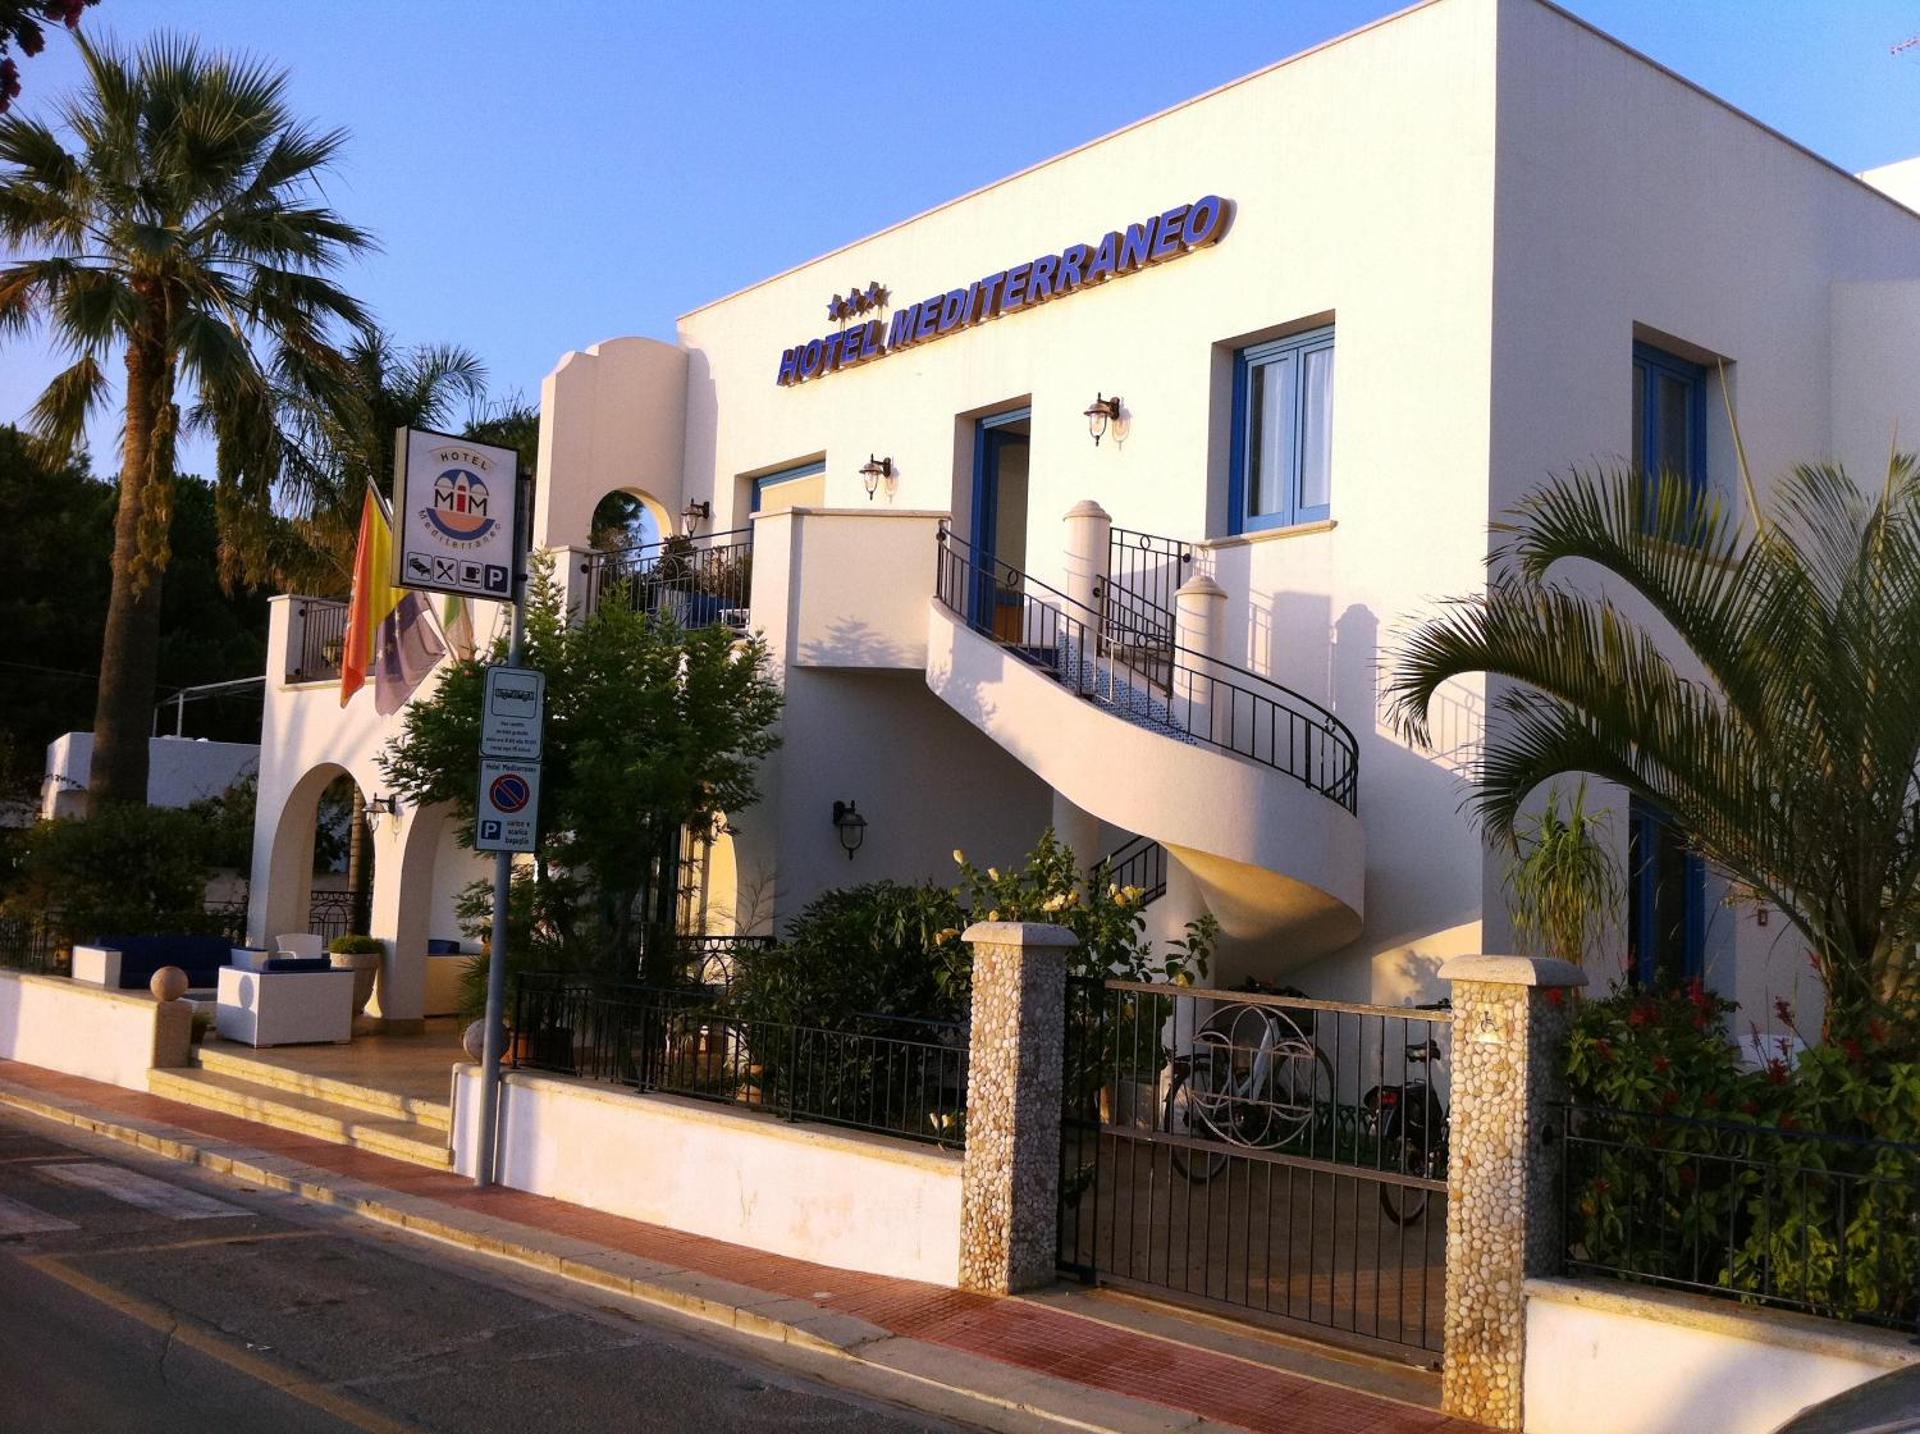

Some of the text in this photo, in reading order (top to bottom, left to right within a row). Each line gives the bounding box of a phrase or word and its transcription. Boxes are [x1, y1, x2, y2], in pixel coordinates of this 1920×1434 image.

[776, 195, 1234, 387] HOTEL MEDITERRANEO
[440, 451, 488, 471] HOTEL
[489, 569, 503, 588] P
[484, 822, 498, 838] P
